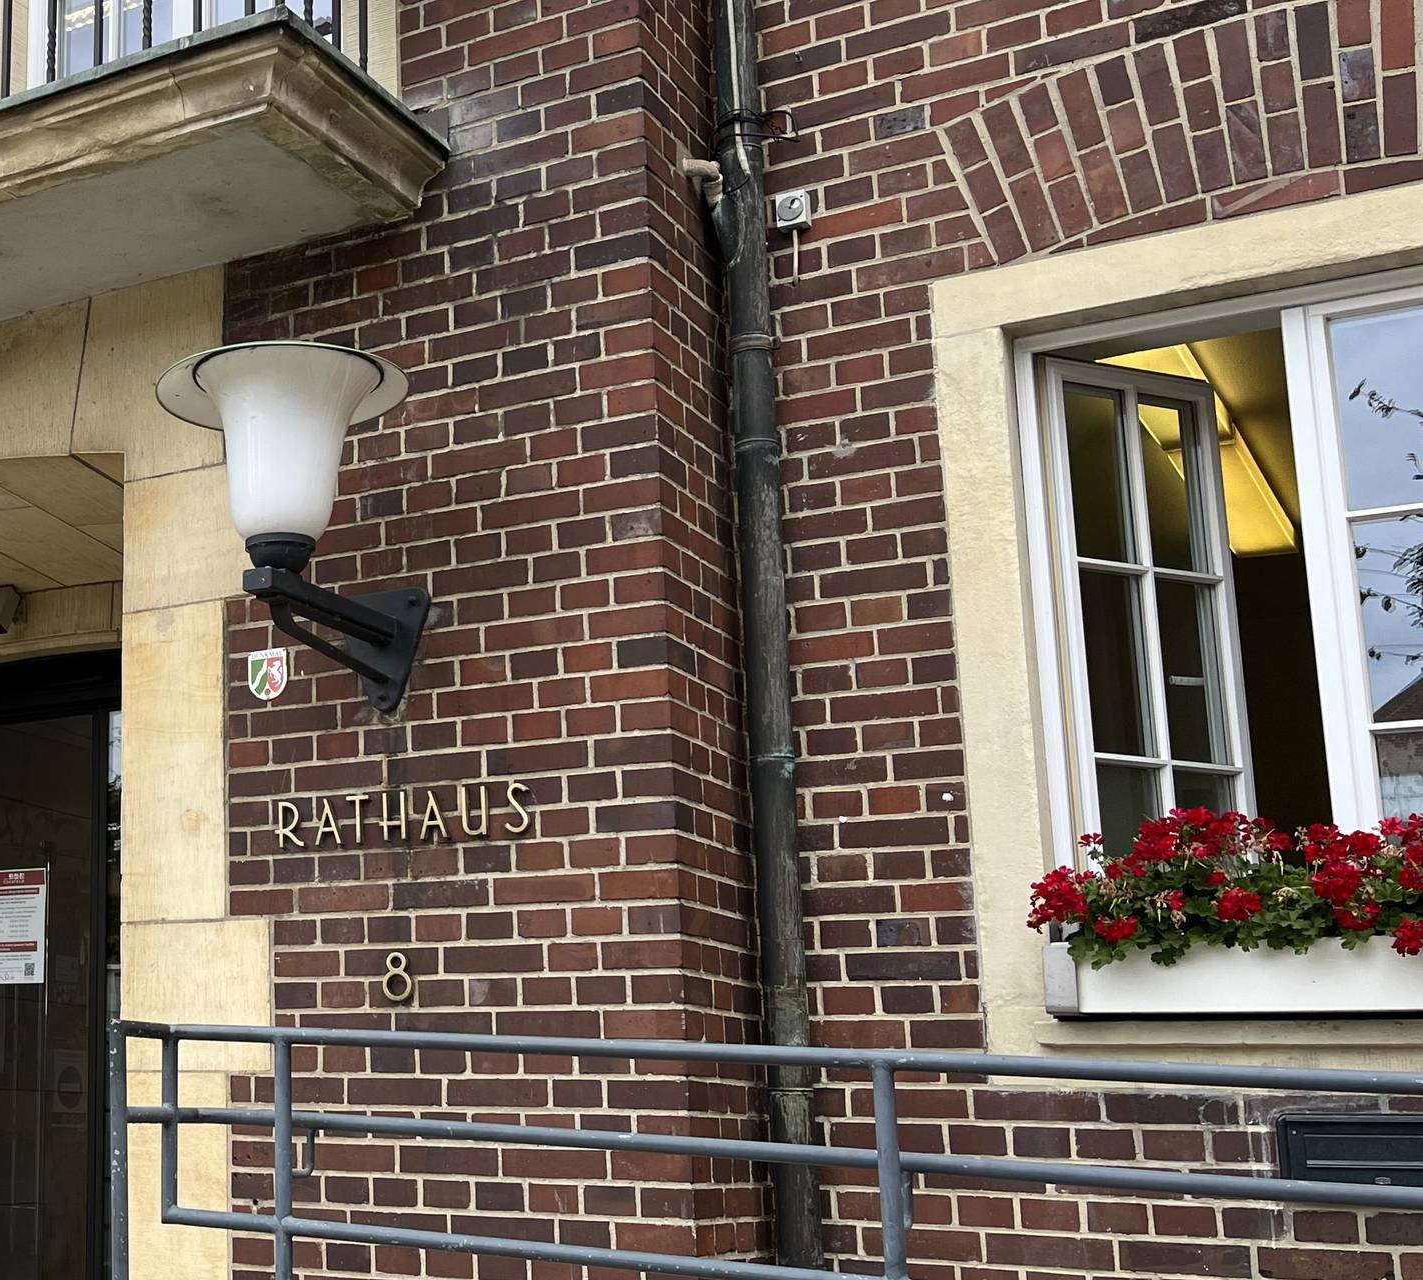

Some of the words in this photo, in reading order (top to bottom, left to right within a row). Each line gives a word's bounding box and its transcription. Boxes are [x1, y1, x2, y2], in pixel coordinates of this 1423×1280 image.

[251, 651, 282, 659] DENKMAL
[275, 783, 529, 848] RATHAUS
[383, 952, 412, 1001] 8
